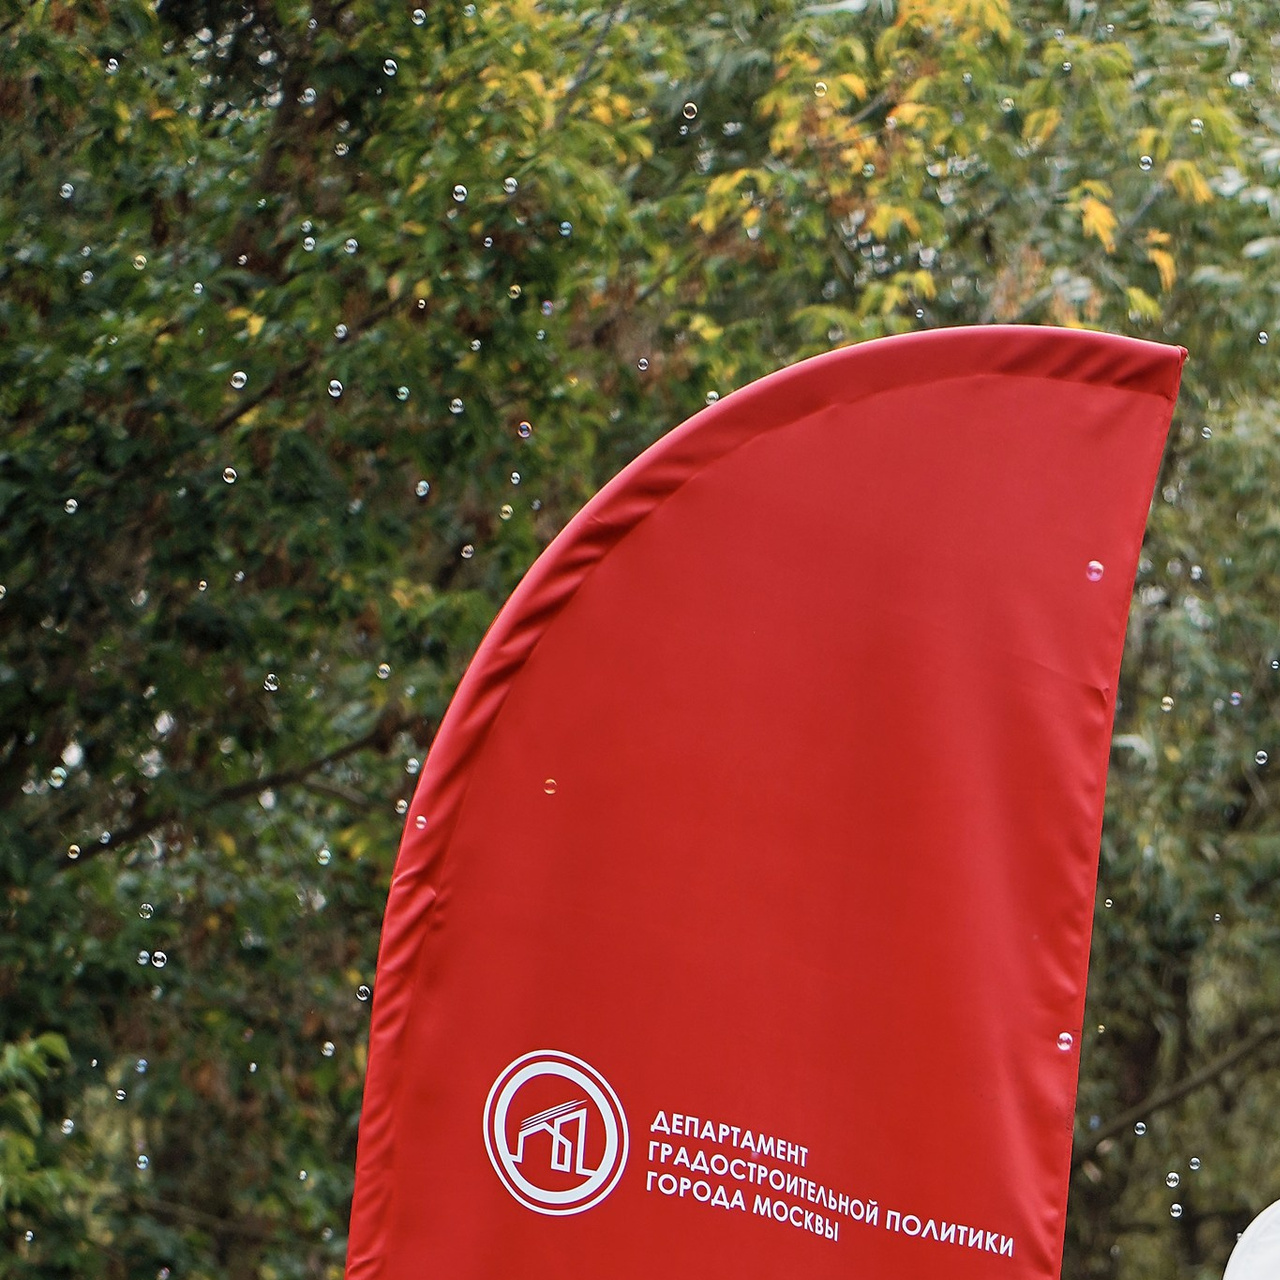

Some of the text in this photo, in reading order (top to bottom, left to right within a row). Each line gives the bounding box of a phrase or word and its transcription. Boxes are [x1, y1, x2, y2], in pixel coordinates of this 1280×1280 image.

[650, 1110, 809, 1168] ДЕПАРТАМЕНТ
[646, 1170, 839, 1242] ГОРОДА МОСКВЫ
[648, 1140, 1014, 1258] ГРАДОСТРОИТЕЛЬНОЙ ПОЛИТИКИ
